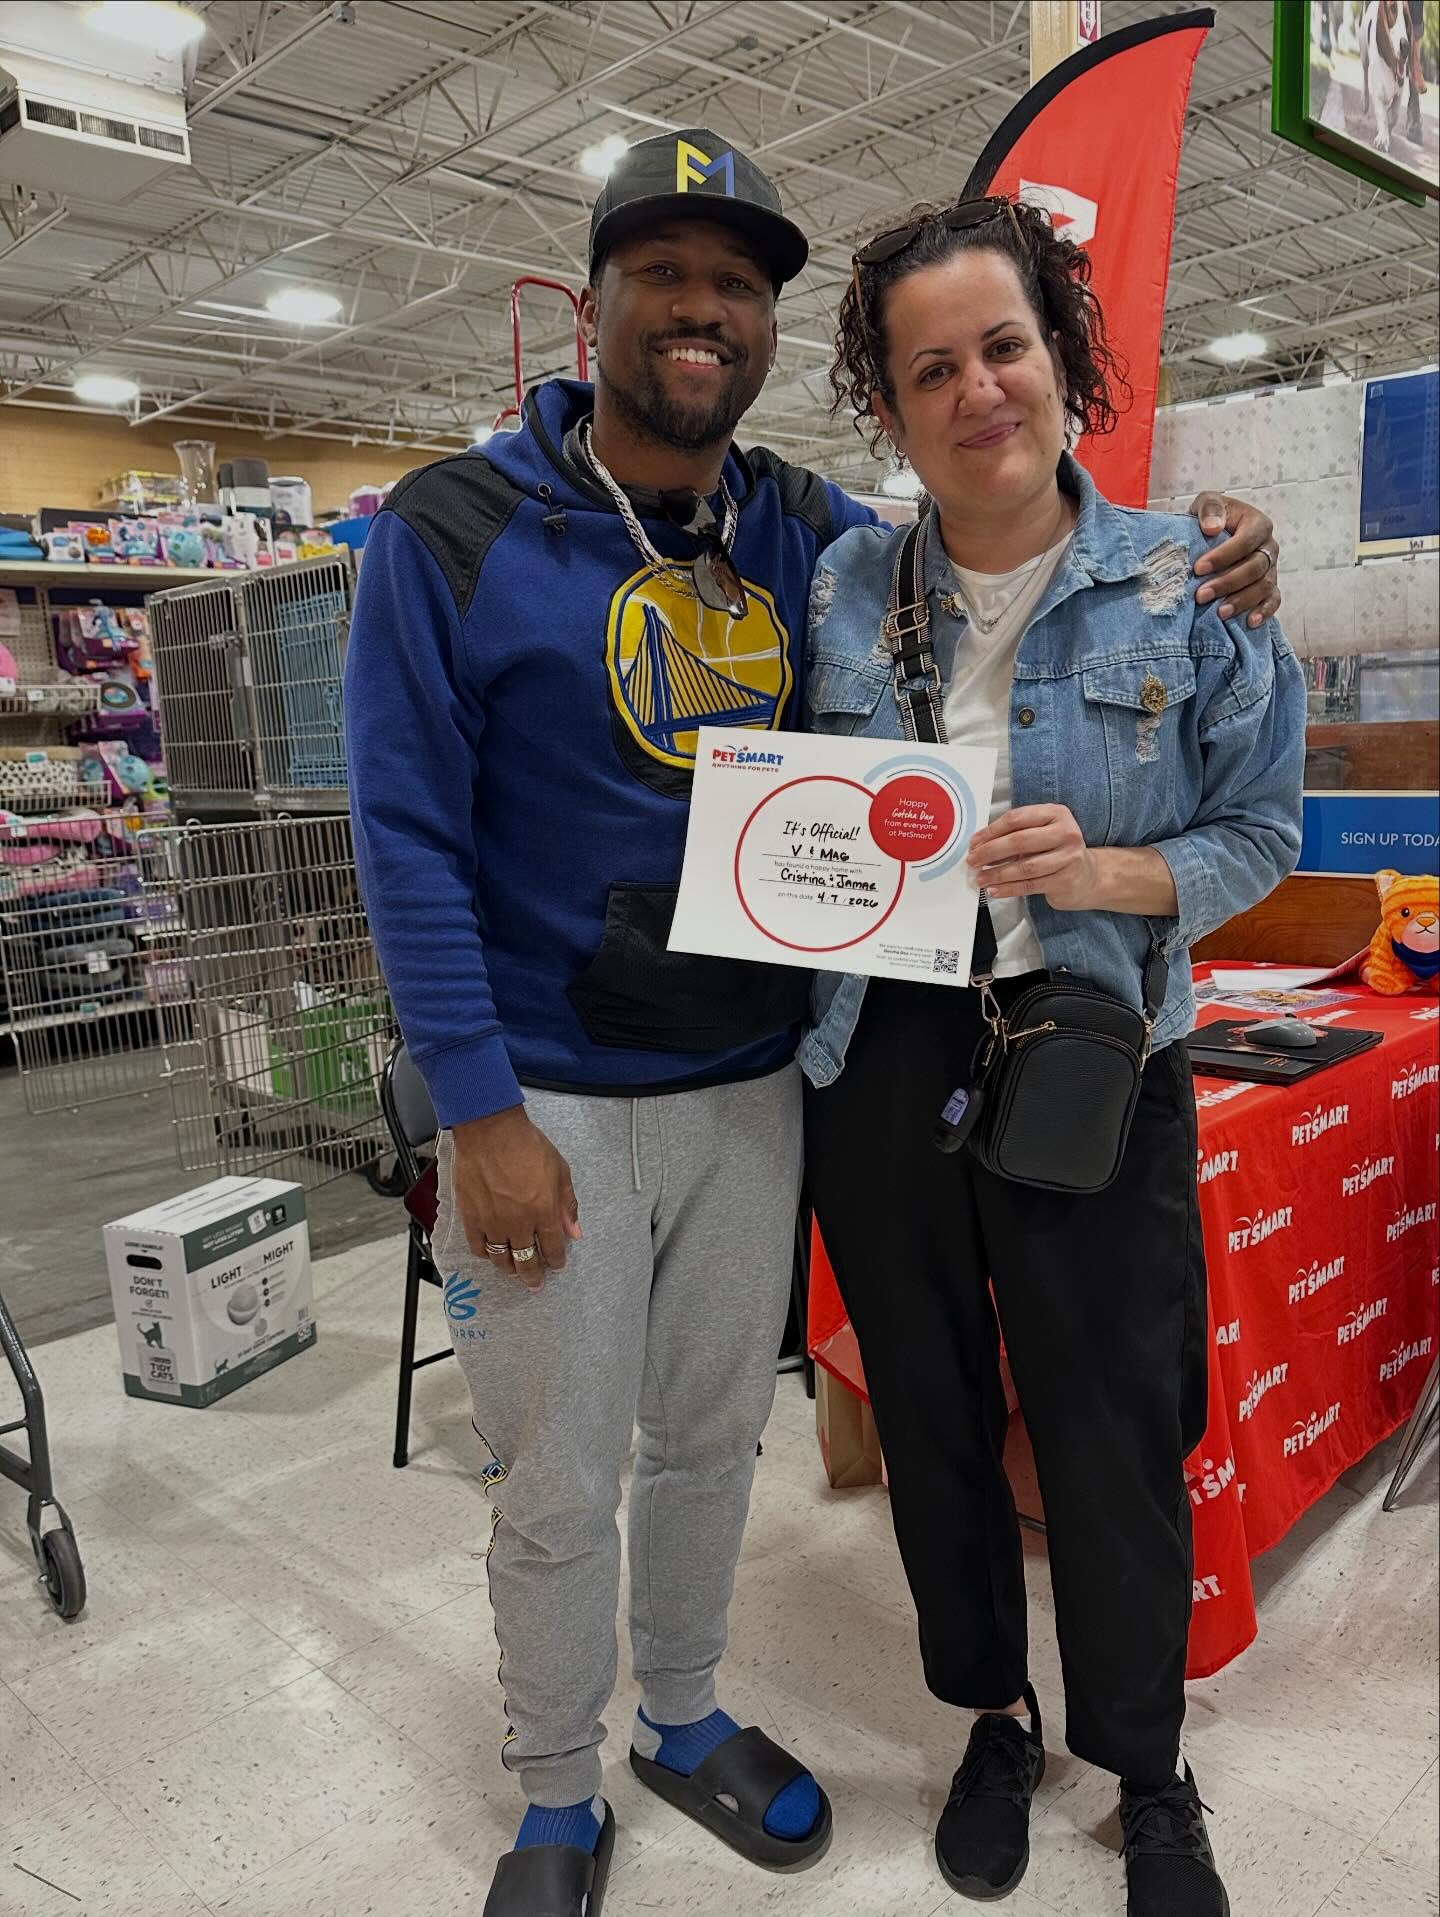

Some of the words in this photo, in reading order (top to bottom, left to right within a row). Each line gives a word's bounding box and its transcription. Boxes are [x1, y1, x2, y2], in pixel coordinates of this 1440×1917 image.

[712, 749, 784, 765] PETSMART
[899, 798, 929, 809] Happy
[892, 808, 917, 819] Gotcha
[918, 810, 935, 824] Day
[783, 821, 807, 837] It's
[810, 823, 861, 843] Official!
[884, 819, 902, 827] from
[903, 822, 938, 831] everyone
[898, 830, 933, 840] PetSmart!
[1341, 832, 1376, 845] SIGN
[1380, 833, 1399, 846] UP
[792, 845, 802, 856] V
[787, 861, 804, 869] found
[811, 865, 830, 873] happy
[832, 866, 848, 874] home
[781, 868, 826, 886] Cristina
[799, 892, 814, 900] date
[817, 891, 826, 902] 4
[849, 898, 879, 908] 2026
[1391, 1064, 1439, 1100] PETSMART
[1292, 1104, 1349, 1147] PETSMART
[1342, 1156, 1395, 1198] PETSMART
[1228, 1206, 1293, 1254] PETSMART
[1386, 1202, 1437, 1243] PETSMART
[211, 1265, 242, 1289] LIGHT
[263, 1241, 294, 1263] MIGHT
[133, 1275, 163, 1287] DON'T
[1288, 1255, 1345, 1305] PETSMART
[1337, 1298, 1388, 1346] PETSMART
[150, 1362, 171, 1372] TIDY
[1379, 1336, 1432, 1382] PETSMART
[150, 1370, 174, 1381] CATS
[1283, 1401, 1341, 1459] PETSMART
